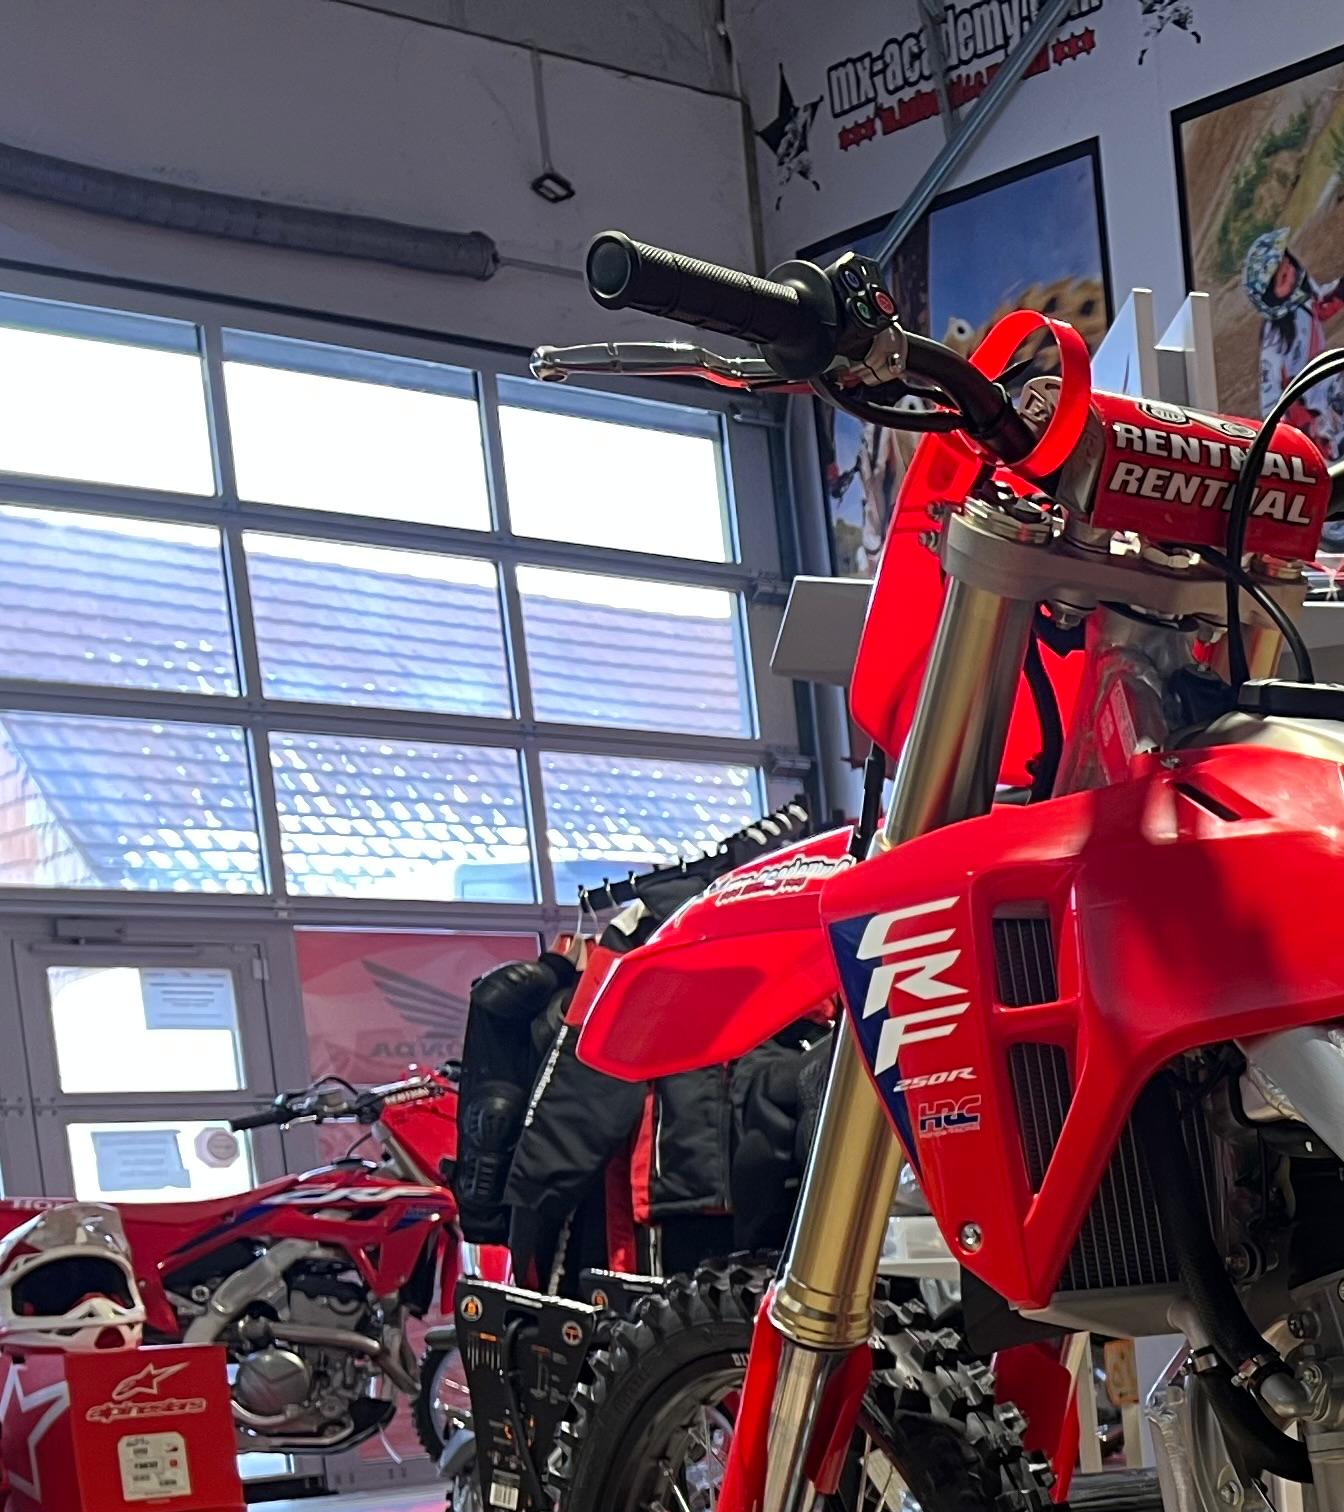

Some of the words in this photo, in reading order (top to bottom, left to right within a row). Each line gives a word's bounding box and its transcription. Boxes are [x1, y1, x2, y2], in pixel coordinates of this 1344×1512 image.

[827, 0, 1101, 118] mx-acdemy.
[1112, 423, 1316, 484] RENTHAL
[856, 896, 971, 1077] CRF
[893, 1067, 977, 1093] 250R
[918, 1094, 982, 1133] HRC
